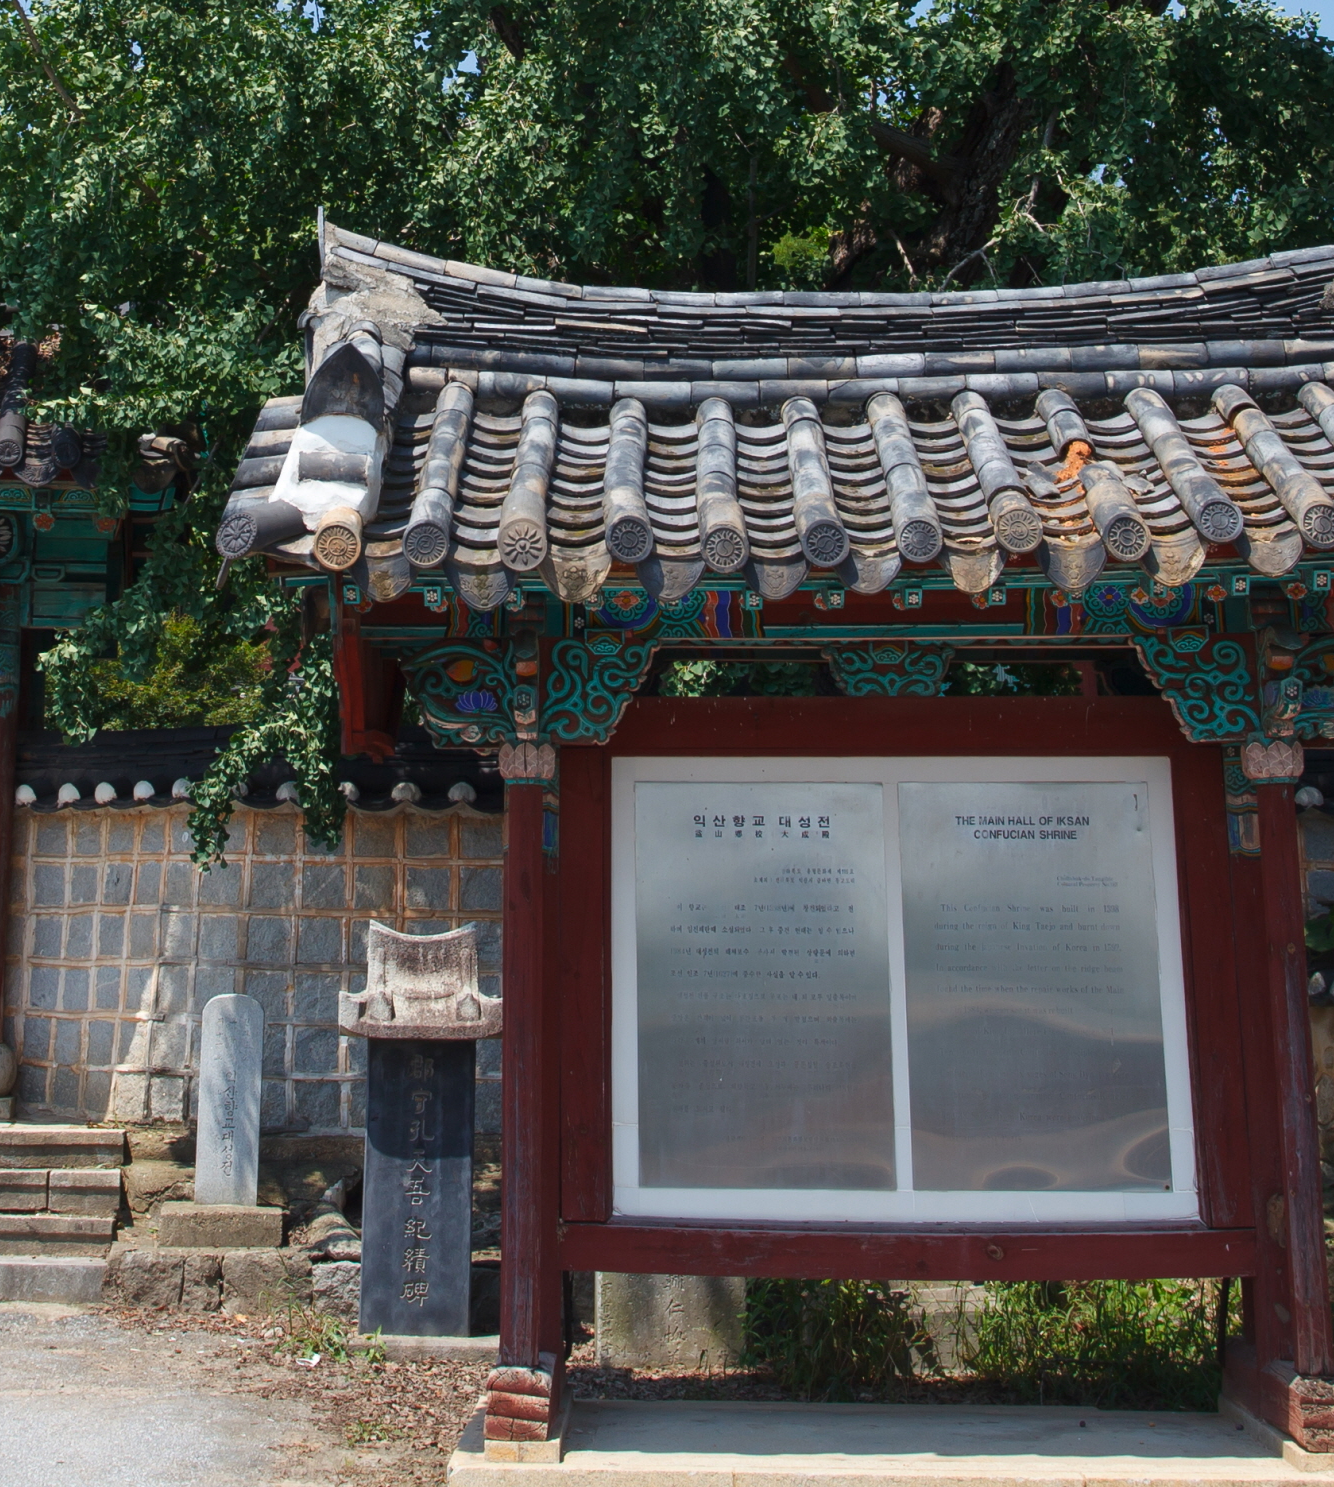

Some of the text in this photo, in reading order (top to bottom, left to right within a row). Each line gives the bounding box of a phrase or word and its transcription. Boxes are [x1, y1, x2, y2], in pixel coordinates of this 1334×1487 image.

[693, 814, 830, 828] 익산향교 대성전
[955, 816, 1089, 826] THE MAIN HALL OF IKSAN
[973, 830, 1077, 839] CONFUCIAN SHRINE
[940, 904, 957, 912] This
[1062, 904, 1079, 912] built
[934, 922, 959, 930] during
[962, 922, 974, 930] the
[1012, 922, 1031, 931] King
[936, 943, 959, 951] during
[964, 942, 977, 950] the
[1065, 943, 1087, 951] Korea
[947, 964, 988, 972] accordance
[961, 984, 973, 992] the
[1017, 985, 1029, 993] the
